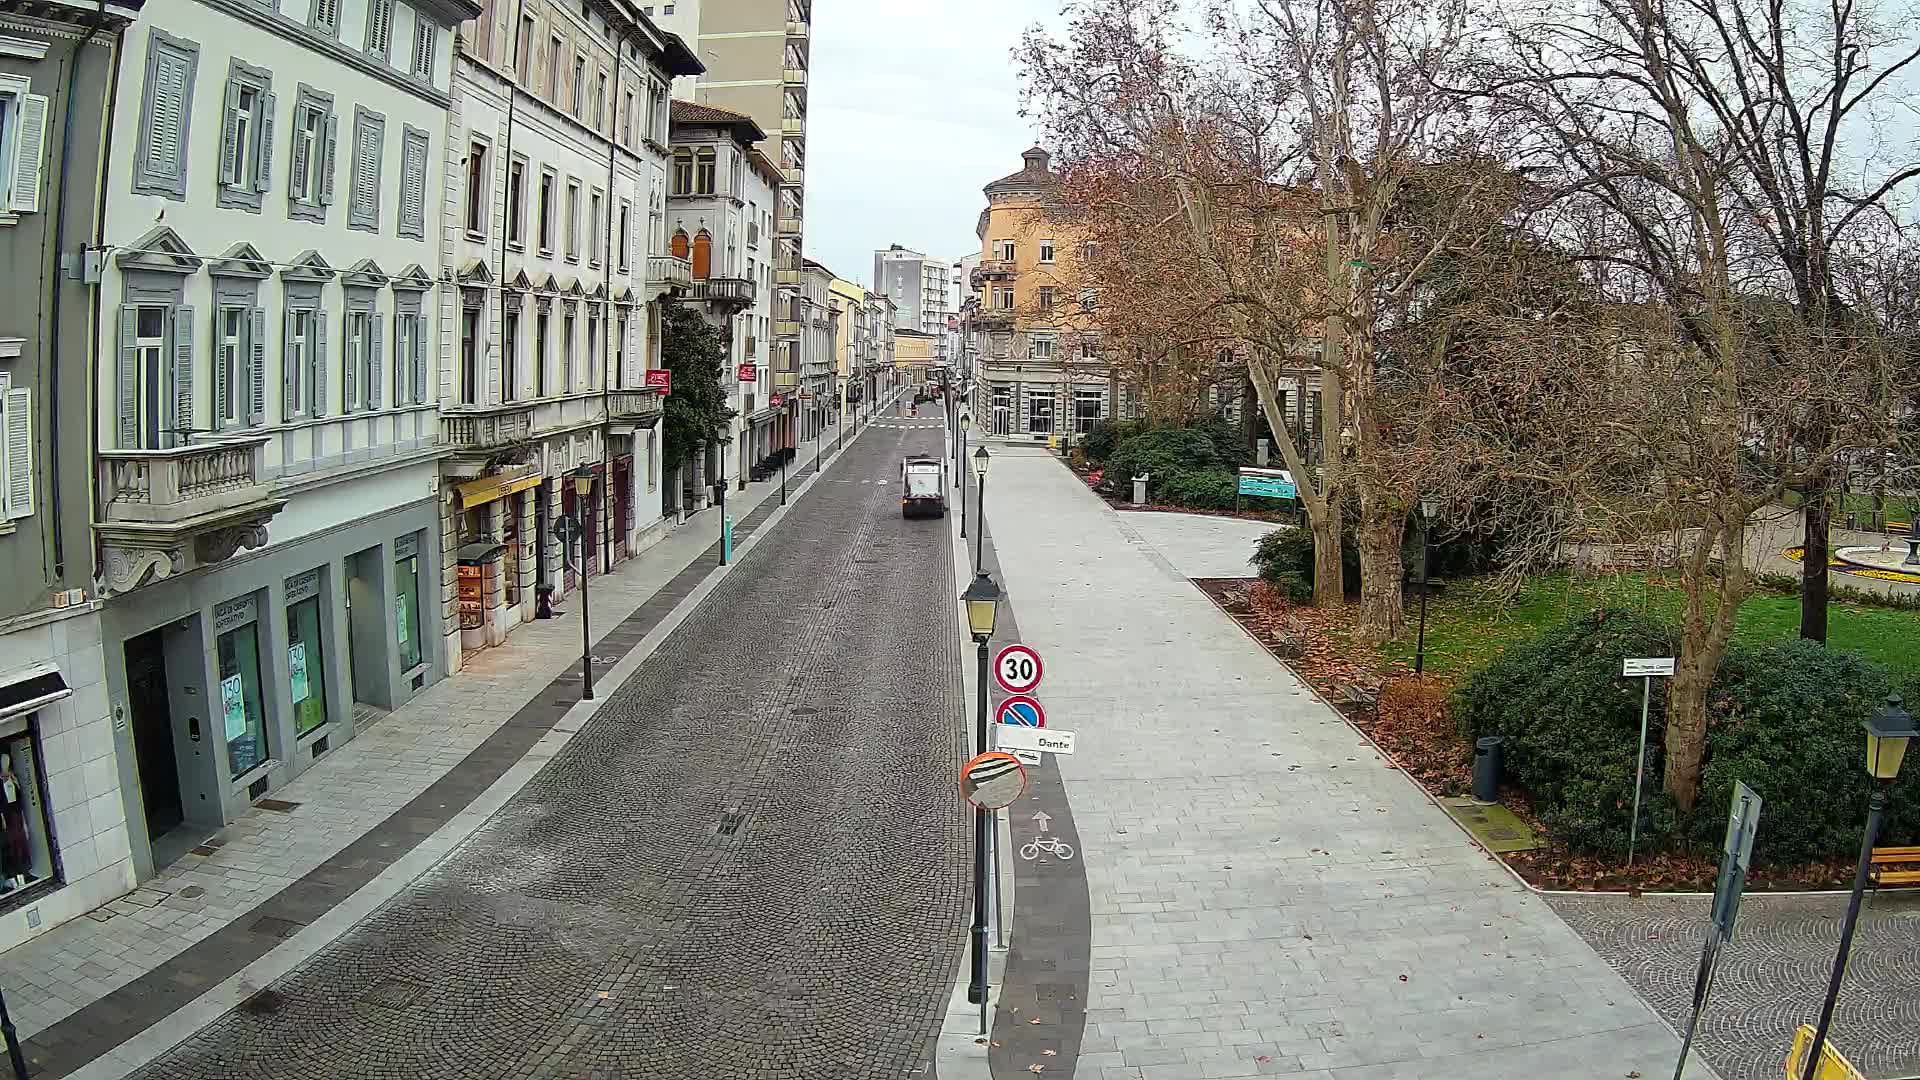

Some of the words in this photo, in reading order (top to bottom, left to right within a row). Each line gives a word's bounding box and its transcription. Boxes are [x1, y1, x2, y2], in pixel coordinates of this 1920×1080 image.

[1005, 658, 1033, 680] 30
[221, 678, 240, 700] 130
[1038, 737, 1070, 749] Dante
